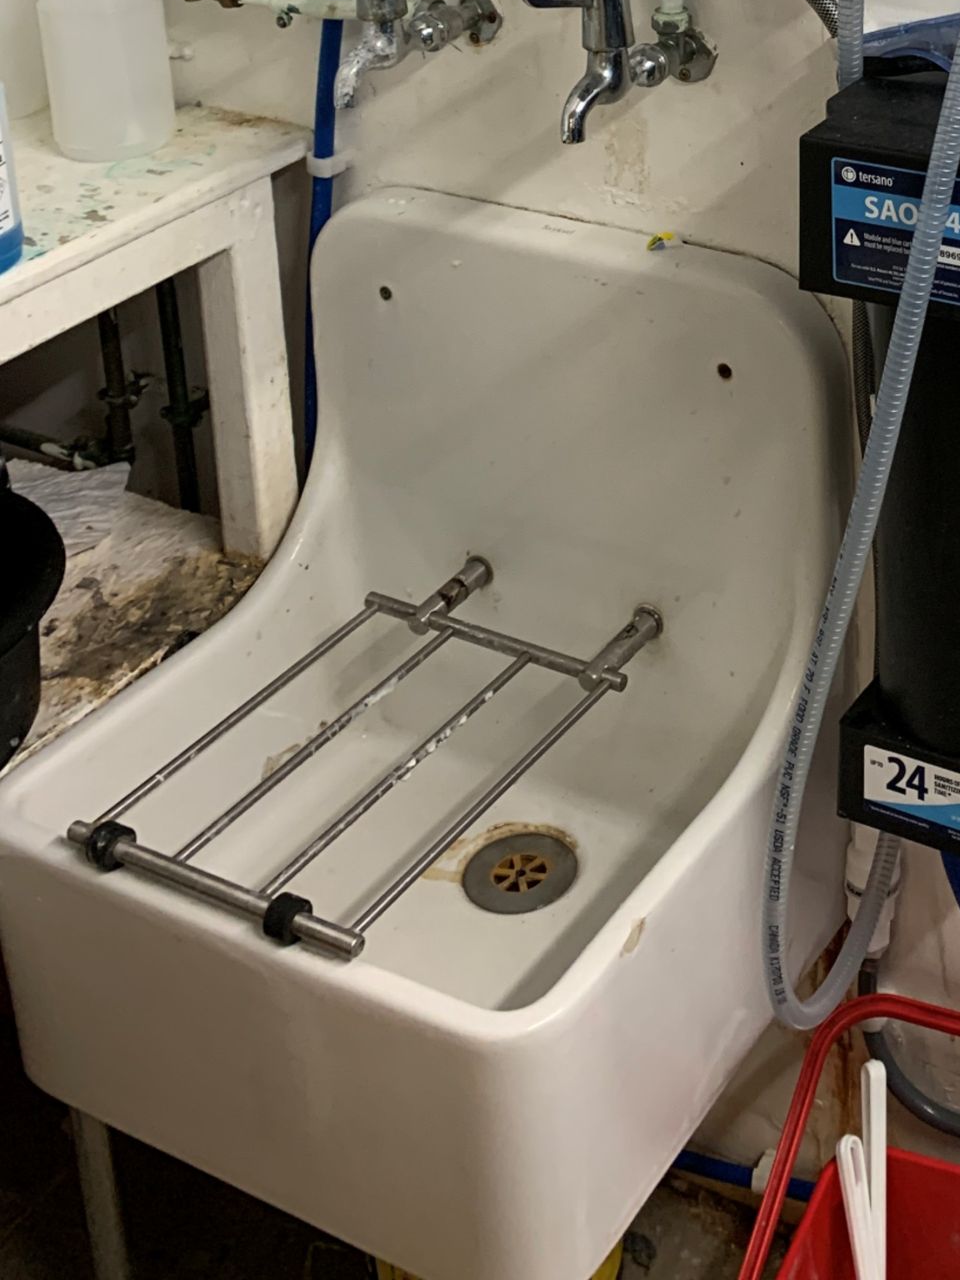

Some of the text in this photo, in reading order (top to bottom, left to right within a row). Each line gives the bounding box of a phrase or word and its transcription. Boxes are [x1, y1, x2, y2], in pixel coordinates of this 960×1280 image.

[859, 171, 893, 187] tersano
[788, 725, 801, 758] GRADE
[783, 760, 795, 781] PVC
[886, 756, 928, 801] 24
[934, 774, 954, 785] HOURS
[772, 829, 785, 853] USDA
[769, 856, 782, 902] ACCEPTED
